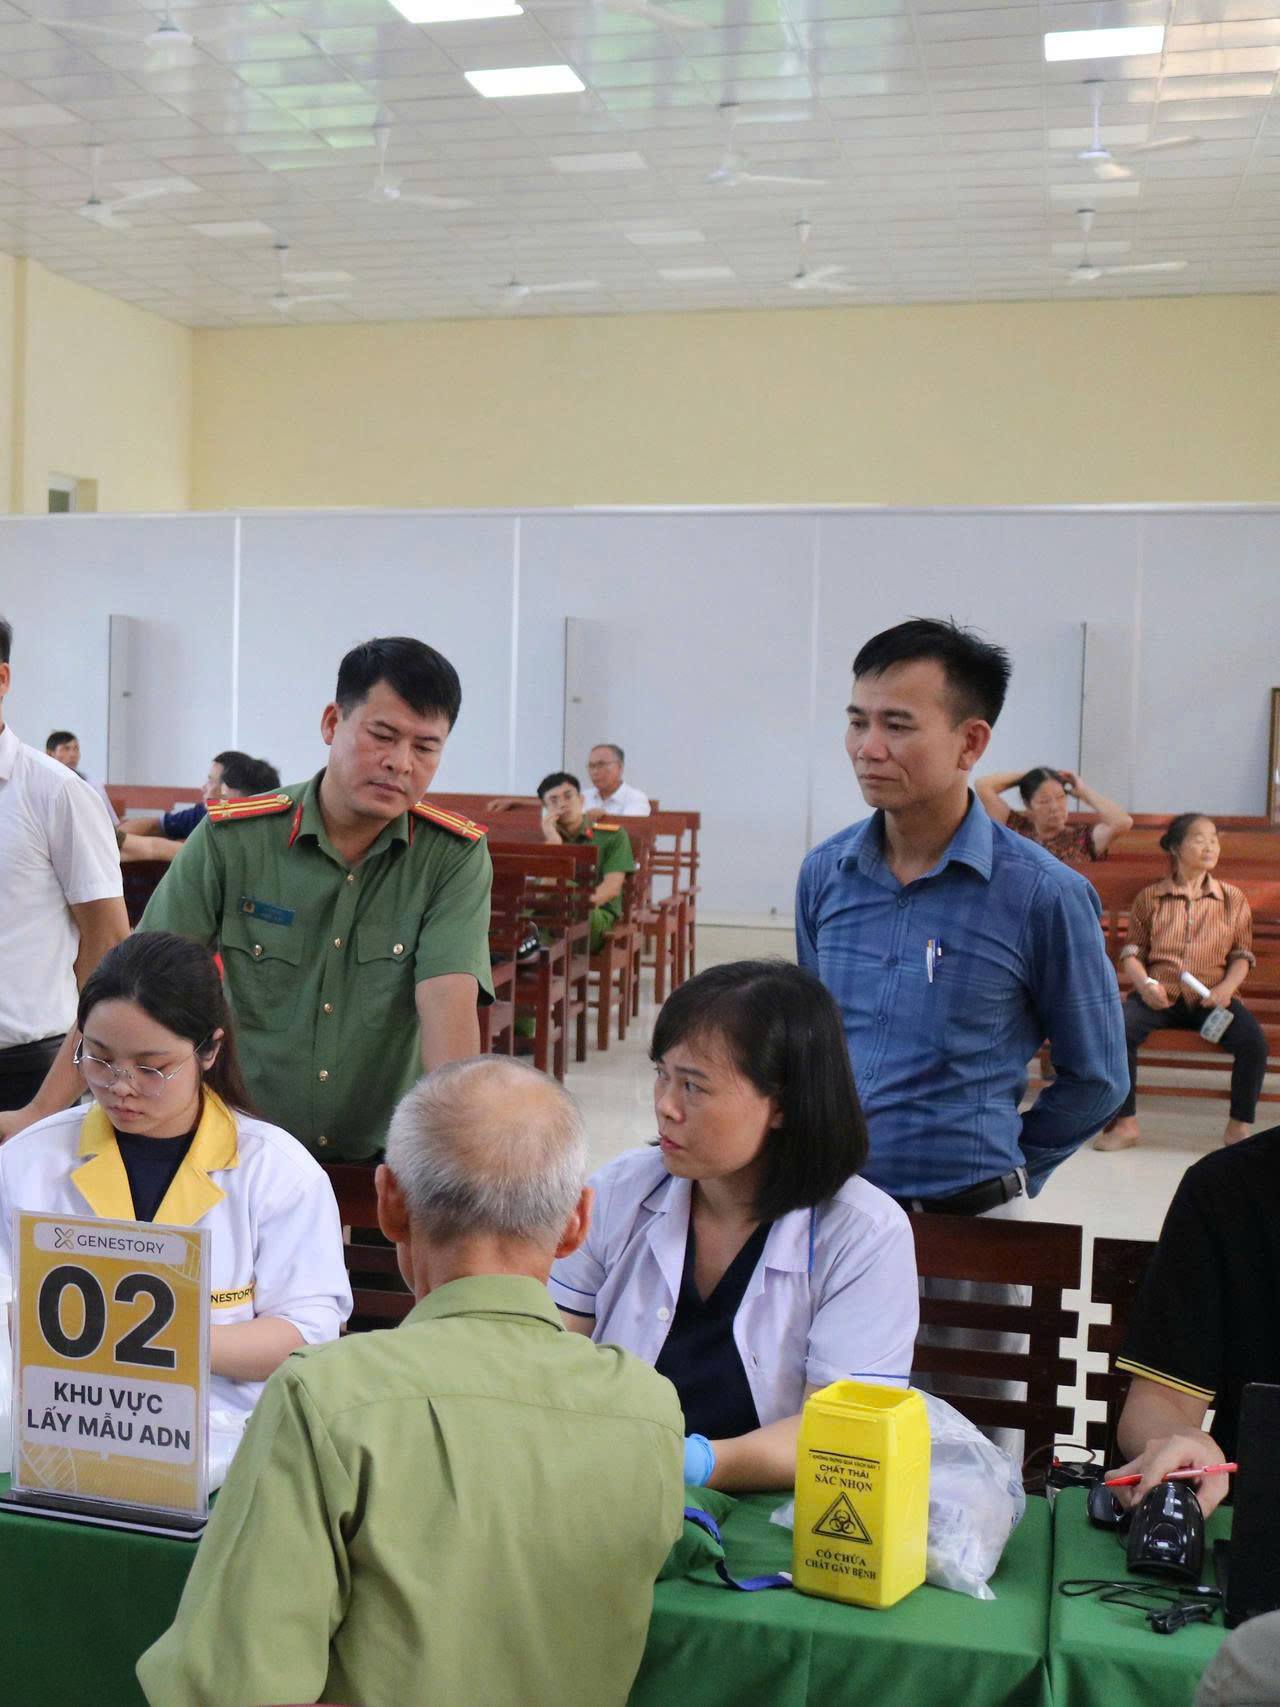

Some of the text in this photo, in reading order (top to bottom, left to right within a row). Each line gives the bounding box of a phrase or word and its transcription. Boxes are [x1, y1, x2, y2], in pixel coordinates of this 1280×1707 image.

[77, 1234, 165, 1255] GENESTORY
[38, 1265, 176, 1369] 02
[54, 1381, 163, 1416] KHU VỰC
[27, 1405, 191, 1450] LẤY MẪU ADN
